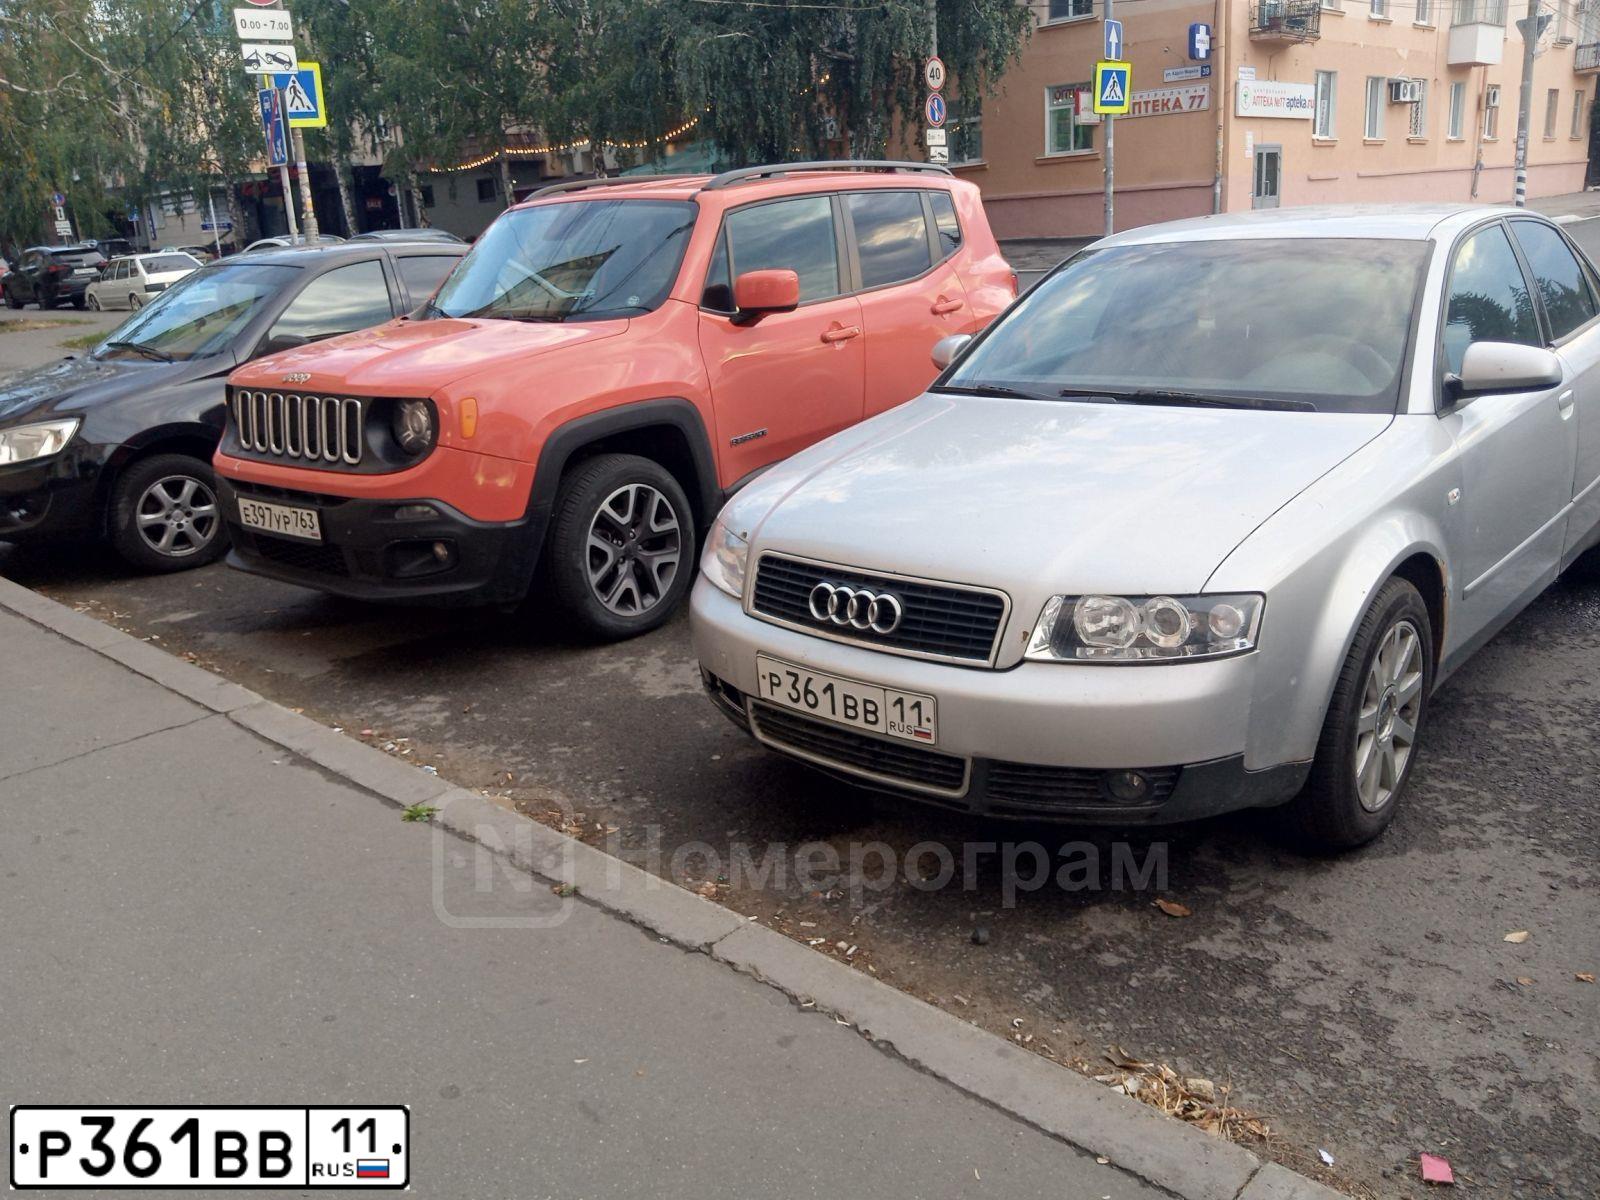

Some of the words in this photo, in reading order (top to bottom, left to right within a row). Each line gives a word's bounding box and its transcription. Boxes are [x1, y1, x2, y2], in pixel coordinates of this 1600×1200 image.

[240, 18, 261, 29] 0.00
[269, 20, 289, 30] 7.00
[929, 67, 941, 80] 40
[1128, 96, 1183, 114] ПТЕКА
[1188, 94, 1205, 109] 77
[1252, 95, 1273, 107] АПТЕКА
[292, 510, 315, 530] 763
[768, 670, 879, 726] Р361ВВ
[892, 696, 922, 726] 11
[889, 720, 913, 735] RUS
